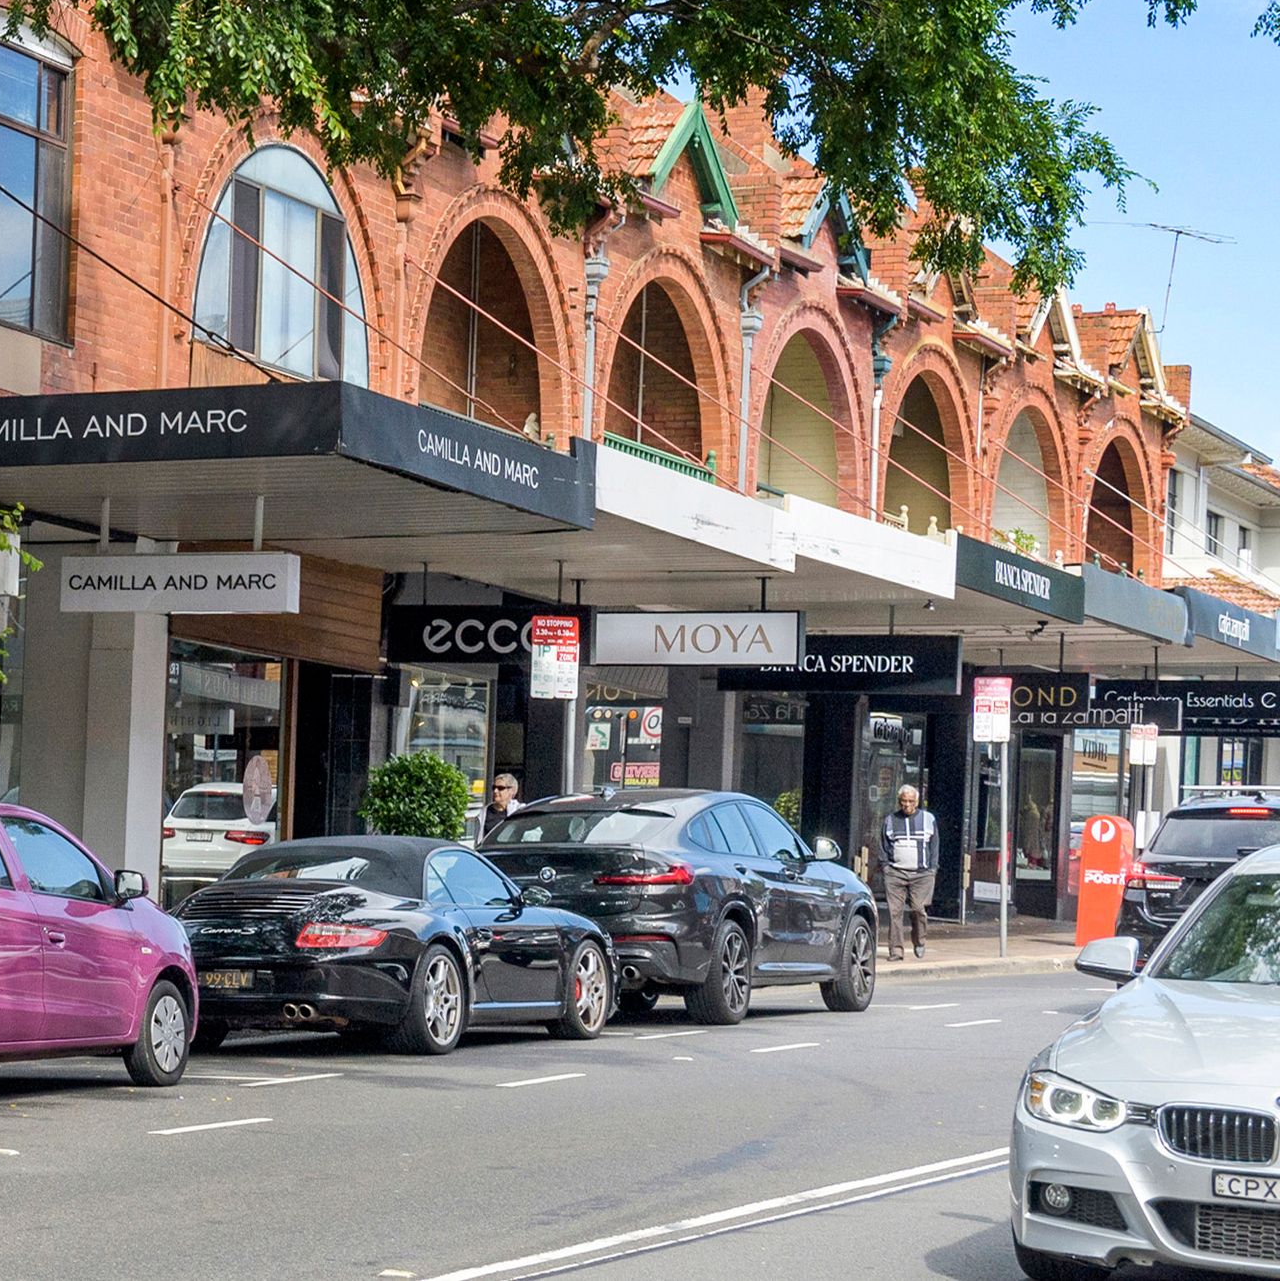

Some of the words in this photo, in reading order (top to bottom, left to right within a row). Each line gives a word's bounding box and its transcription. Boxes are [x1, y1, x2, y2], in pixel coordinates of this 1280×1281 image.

[83, 413, 147, 438] AND
[160, 409, 248, 435] MARC
[418, 429, 471, 467] CAMILLA
[474, 449, 501, 476] AND
[505, 458, 539, 489] MARC
[69, 574, 156, 591] CAMILLA
[164, 574, 208, 590] AND
[216, 574, 277, 590] MARC
[995, 559, 1021, 591] BIANCA
[1021, 569, 1051, 600] SPENDER
[654, 624, 773, 653] MOYA
[831, 656, 913, 673] SPENDER
[1187, 692, 1254, 708] Essentials
[1084, 872, 1121, 885] POST
